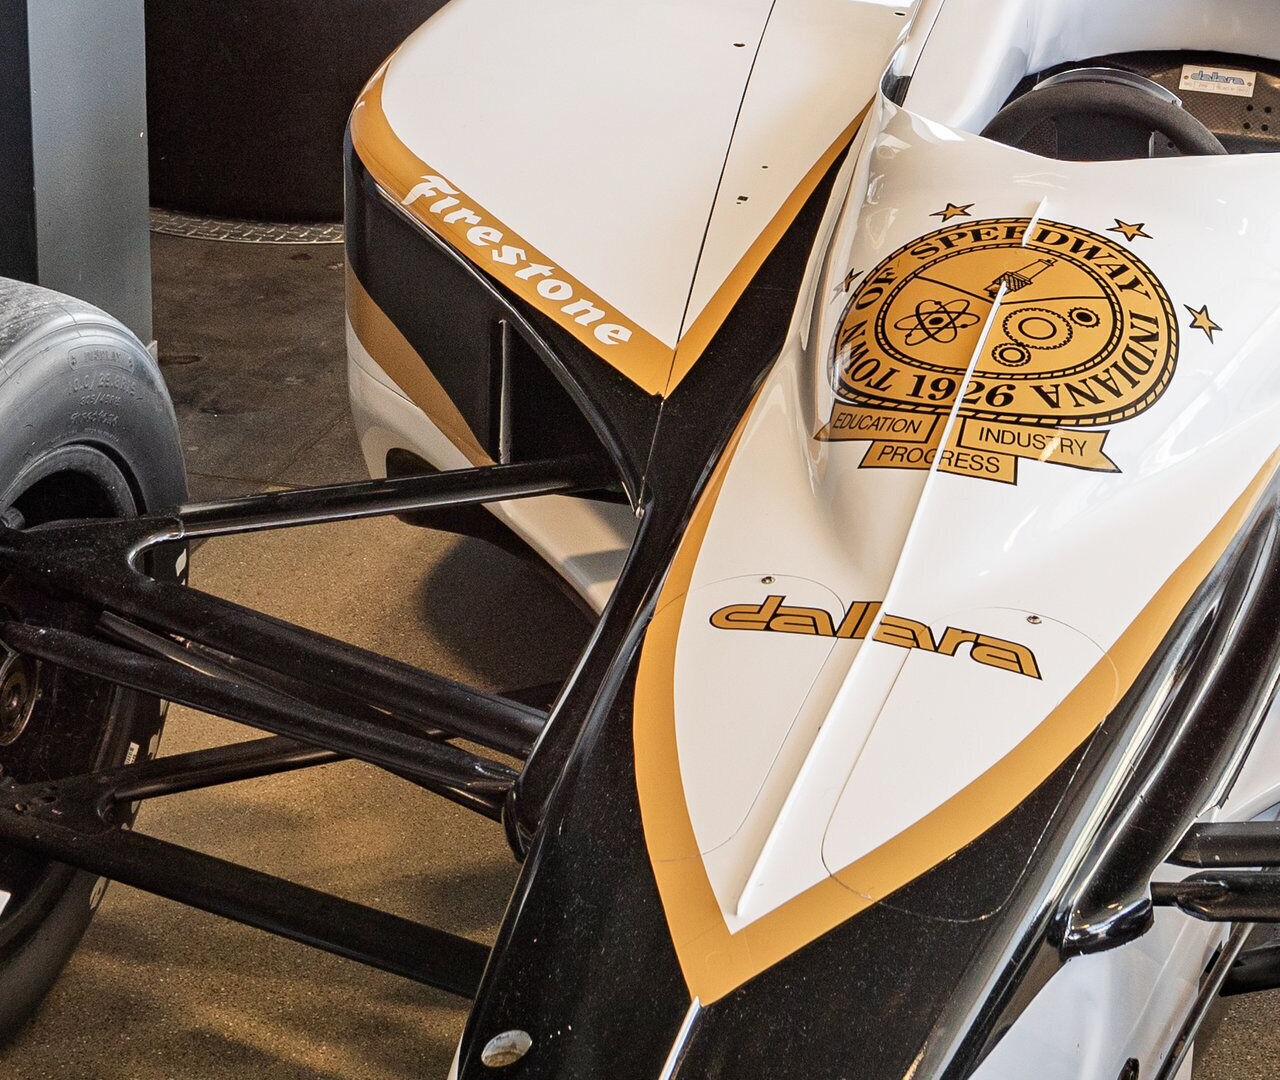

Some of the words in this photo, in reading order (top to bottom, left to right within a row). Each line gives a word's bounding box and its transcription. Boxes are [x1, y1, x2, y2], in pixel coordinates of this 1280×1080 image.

[400, 175, 633, 345] Firestone
[855, 266, 898, 310] OF
[910, 225, 1152, 301] SPEEDWAY
[841, 320, 902, 393] TOWN
[905, 374, 1017, 408] 1926
[1029, 309, 1160, 410] INDIANA
[833, 411, 923, 434] EDUCATION
[709, 595, 1043, 681] dallara
